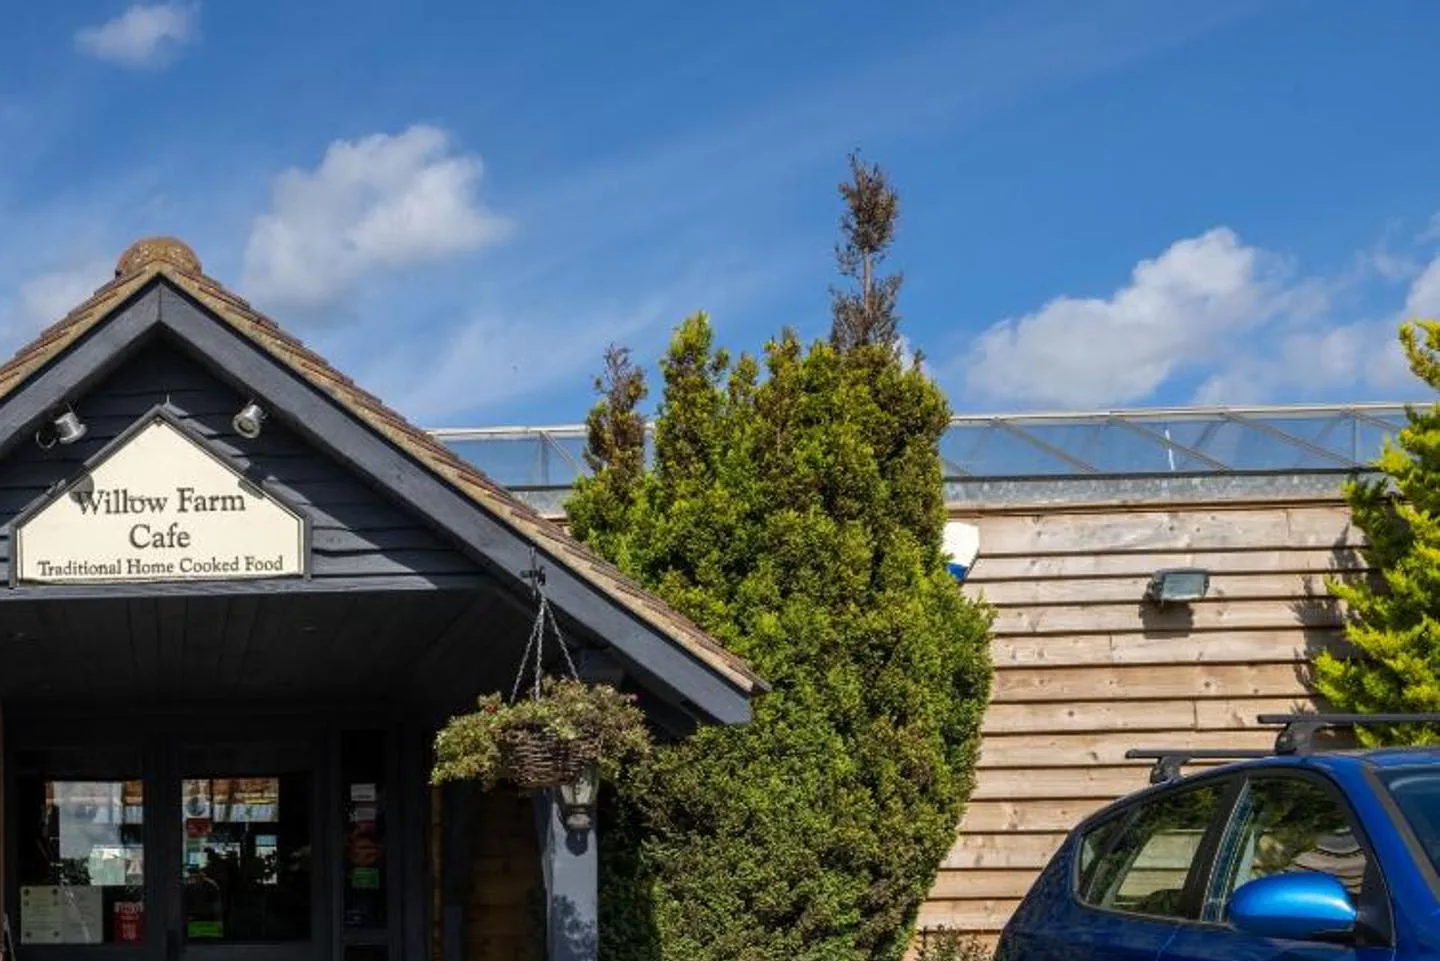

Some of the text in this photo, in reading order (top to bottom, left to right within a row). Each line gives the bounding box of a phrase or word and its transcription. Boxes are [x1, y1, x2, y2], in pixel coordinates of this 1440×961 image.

[75, 487, 246, 515] Willow Farm
[128, 522, 191, 549] Cafe
[37, 555, 283, 576] Traditional Home Cooked Food
